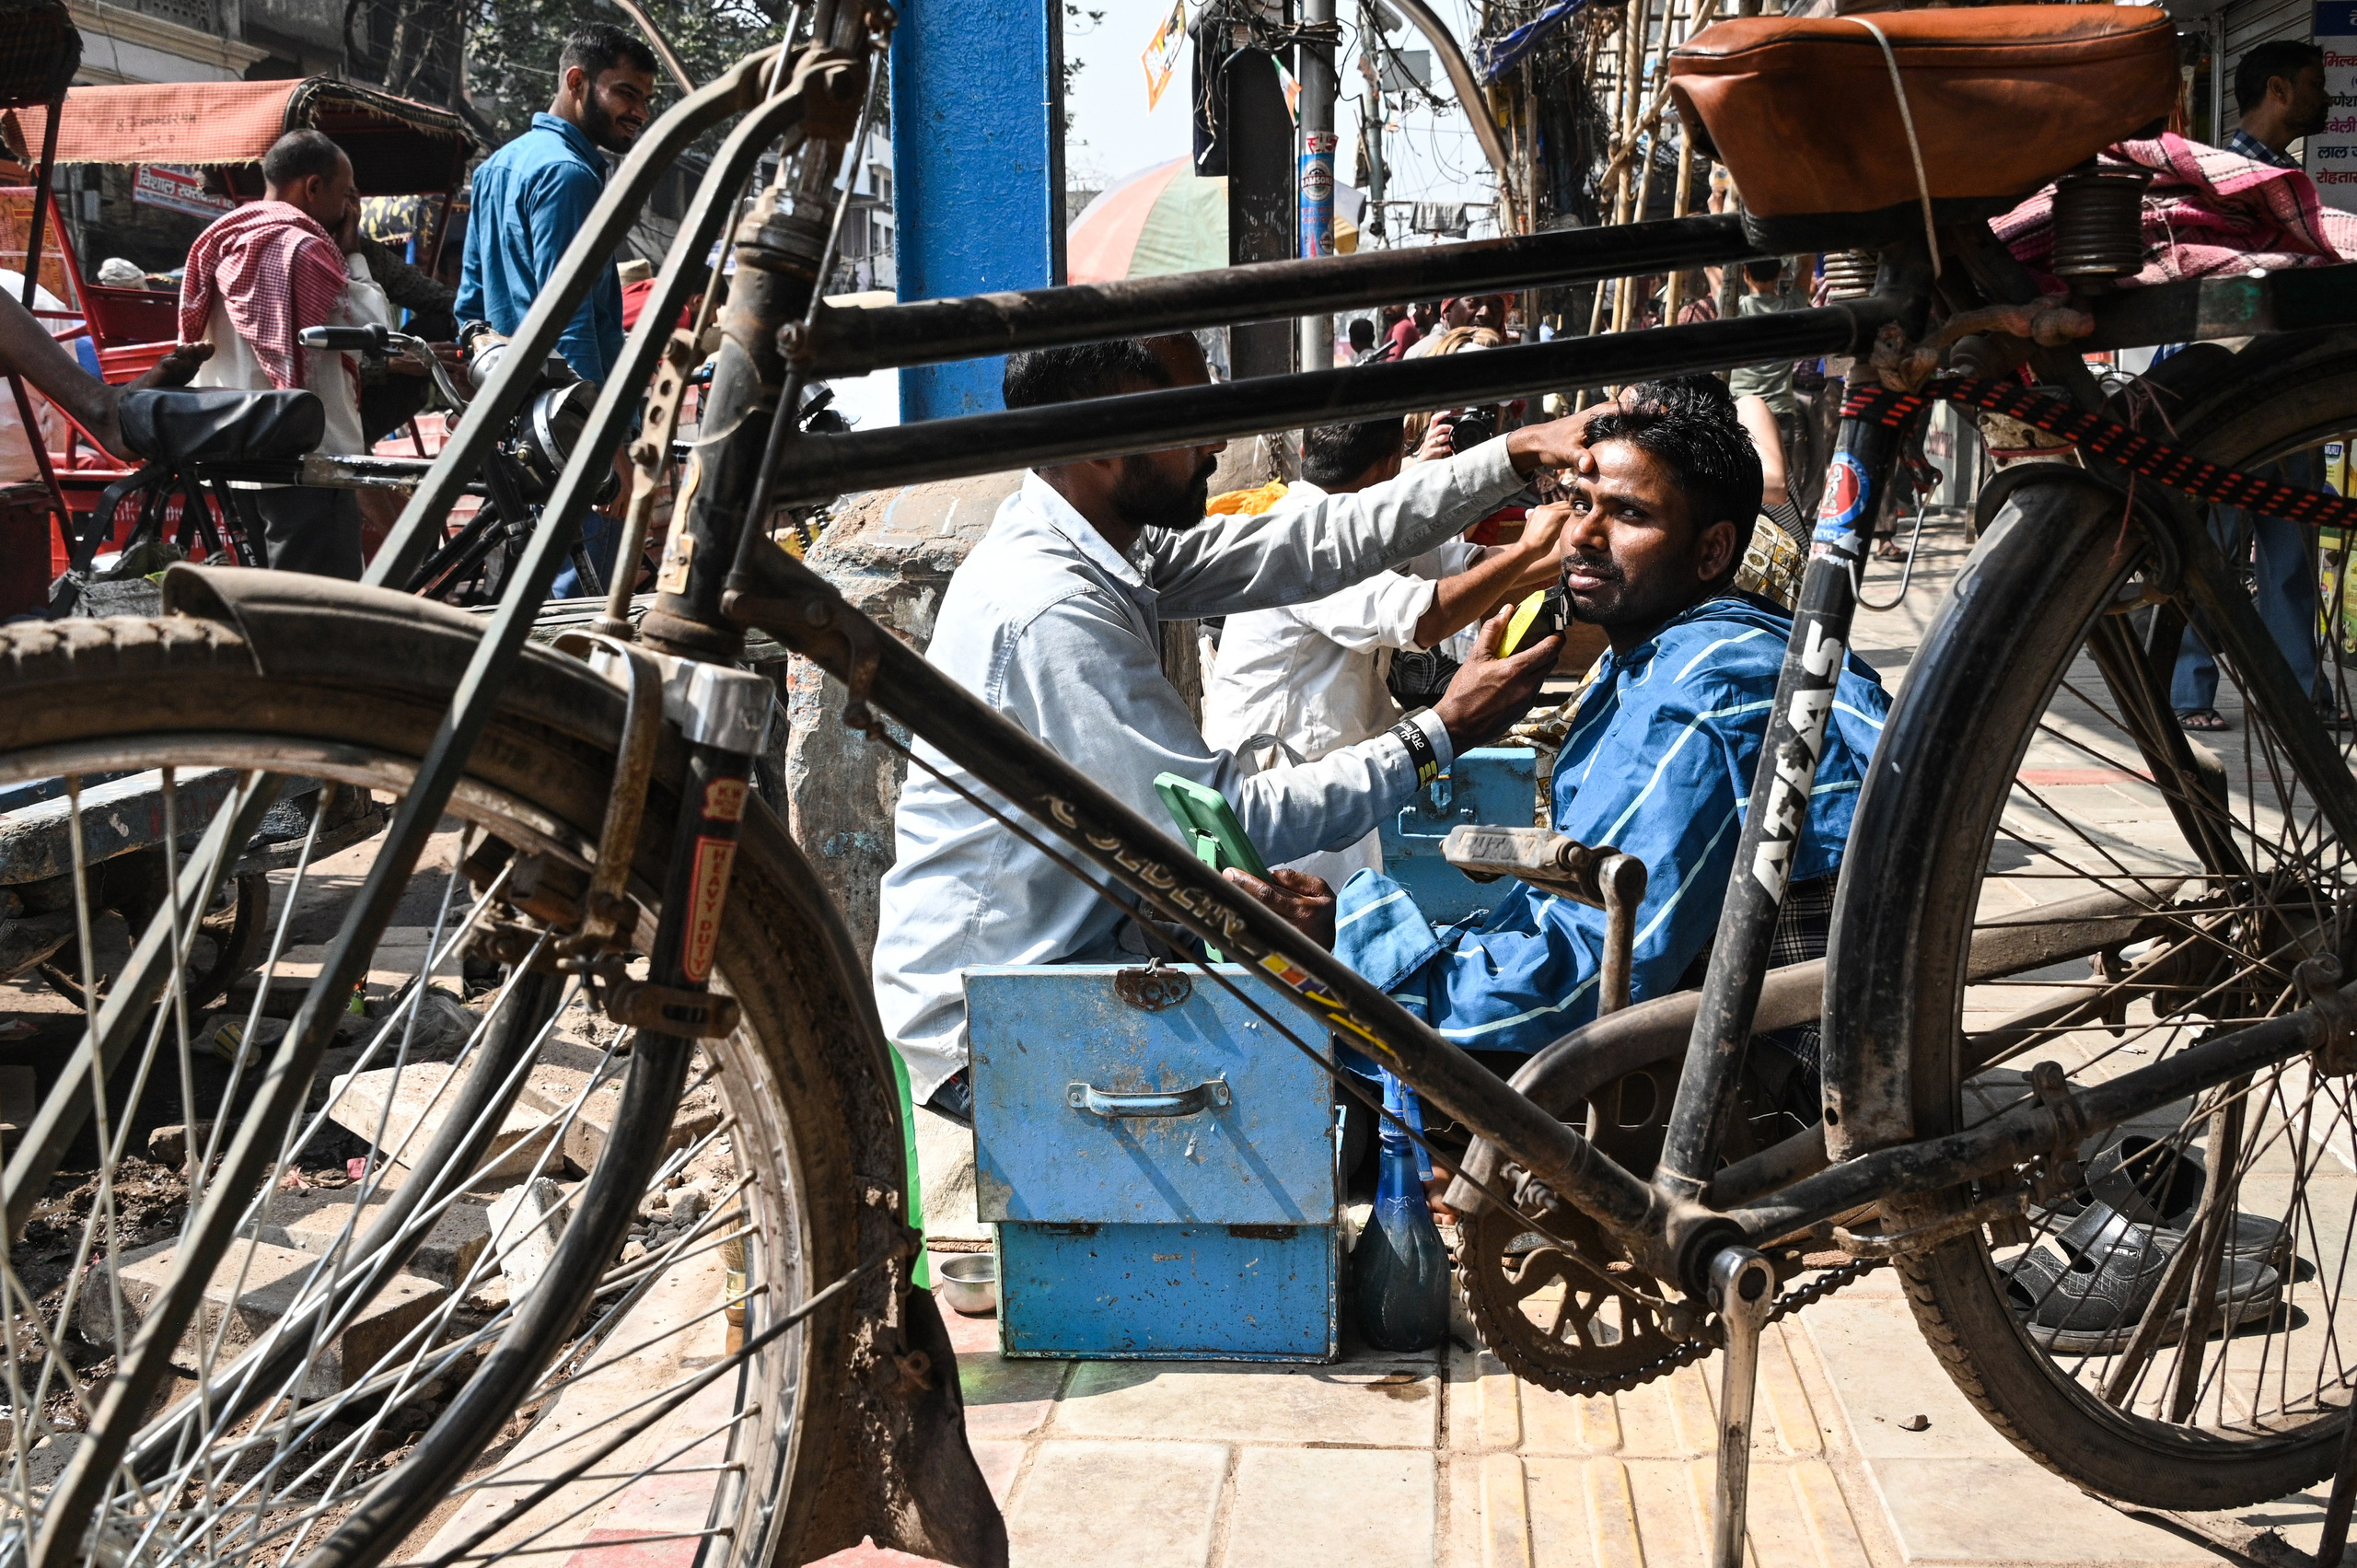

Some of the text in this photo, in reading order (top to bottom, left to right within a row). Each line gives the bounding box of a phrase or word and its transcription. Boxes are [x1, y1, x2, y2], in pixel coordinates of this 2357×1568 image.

[2317, 146, 2349, 159] लाल
[1751, 619, 1840, 907] ATLAS
[695, 849, 726, 971] HEAVY DUTY
